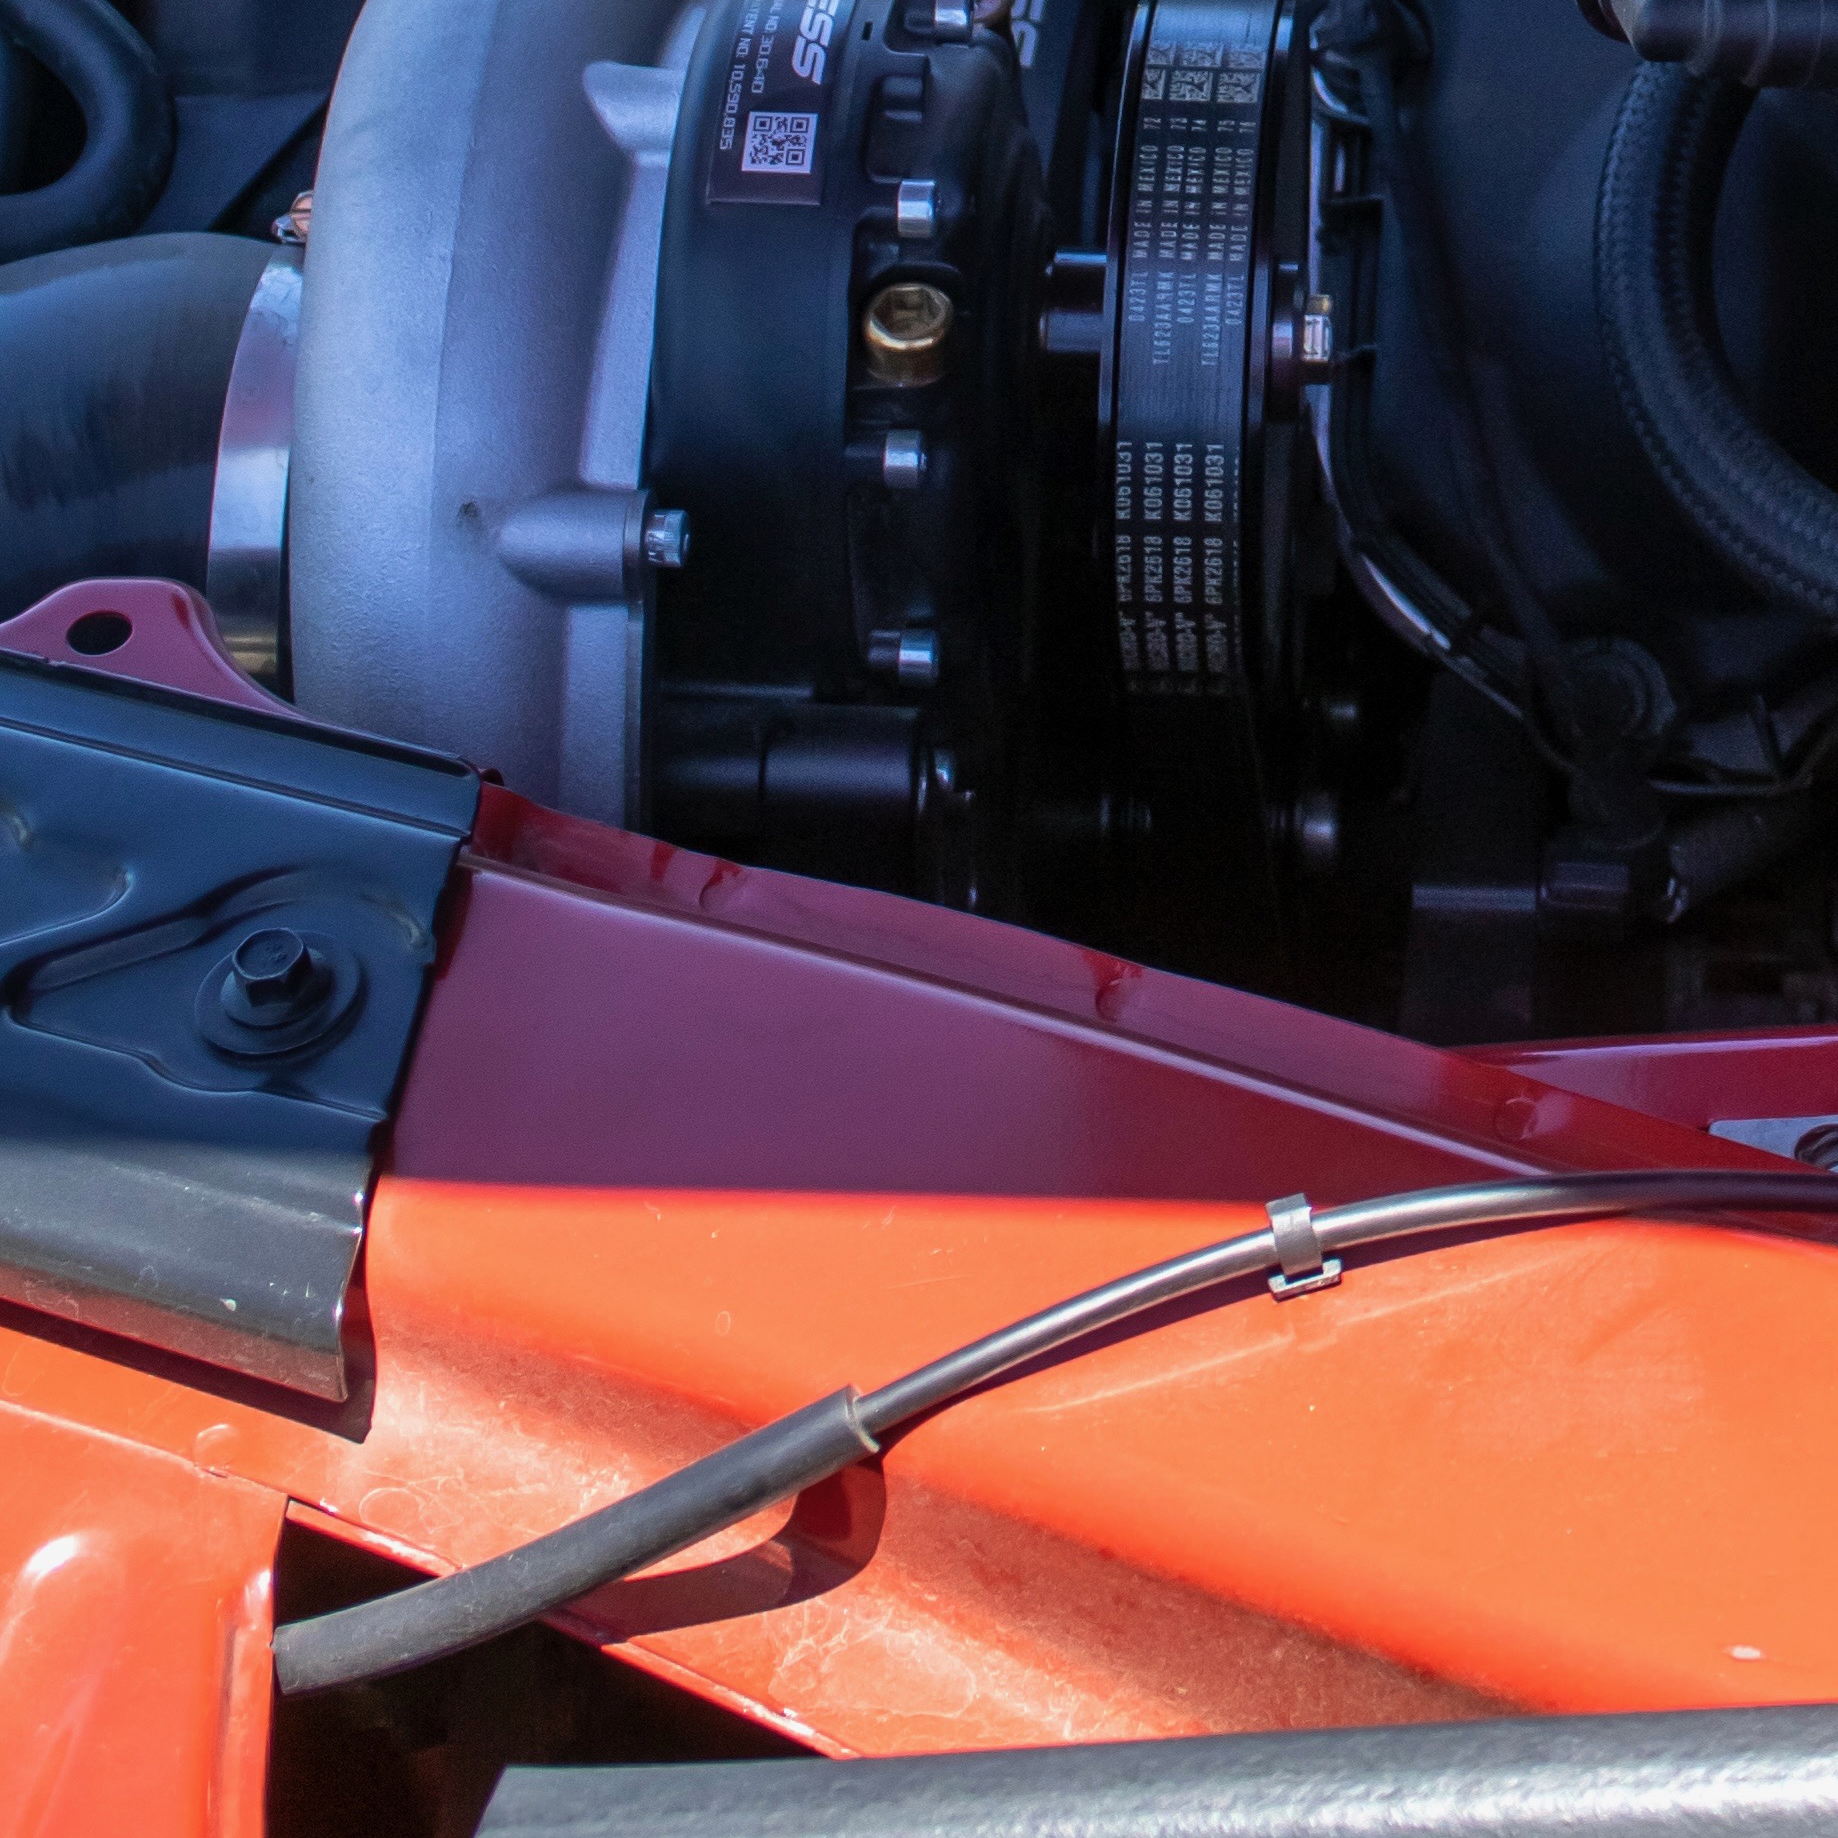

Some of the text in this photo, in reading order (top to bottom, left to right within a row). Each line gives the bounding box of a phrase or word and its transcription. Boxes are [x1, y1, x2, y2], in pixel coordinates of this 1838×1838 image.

[1137, 145, 1159, 192] MEXICO
[1164, 145, 1185, 192] MEXICO
[1185, 147, 1206, 194] MEXICO
[1212, 147, 1232, 194] MEXICO
[1234, 148, 1254, 195] MEXICO
[1136, 200, 1152, 213] IN
[1163, 200, 1179, 213] IN
[1184, 202, 1201, 215] IN
[1211, 202, 1227, 215] IN
[1232, 203, 1248, 217] IN
[1132, 222, 1151, 258] MADE
[1159, 222, 1178, 258] MADE
[1181, 223, 1200, 260] MADE
[1208, 224, 1226, 260] MADE
[1230, 225, 1248, 262] MADE
[1128, 271, 1148, 322] 0423TL
[1177, 273, 1196, 323] 0423TL
[1225, 275, 1244, 325] 0423TL
[1144, 441, 1164, 520] K061031
[1173, 442, 1194, 522] K061031
[1204, 443, 1225, 523] K061031
[1144, 535, 1164, 603] 6PK2618
[1173, 536, 1193, 604] 6PK2618
[1204, 537, 1224, 605] 6PK2618
